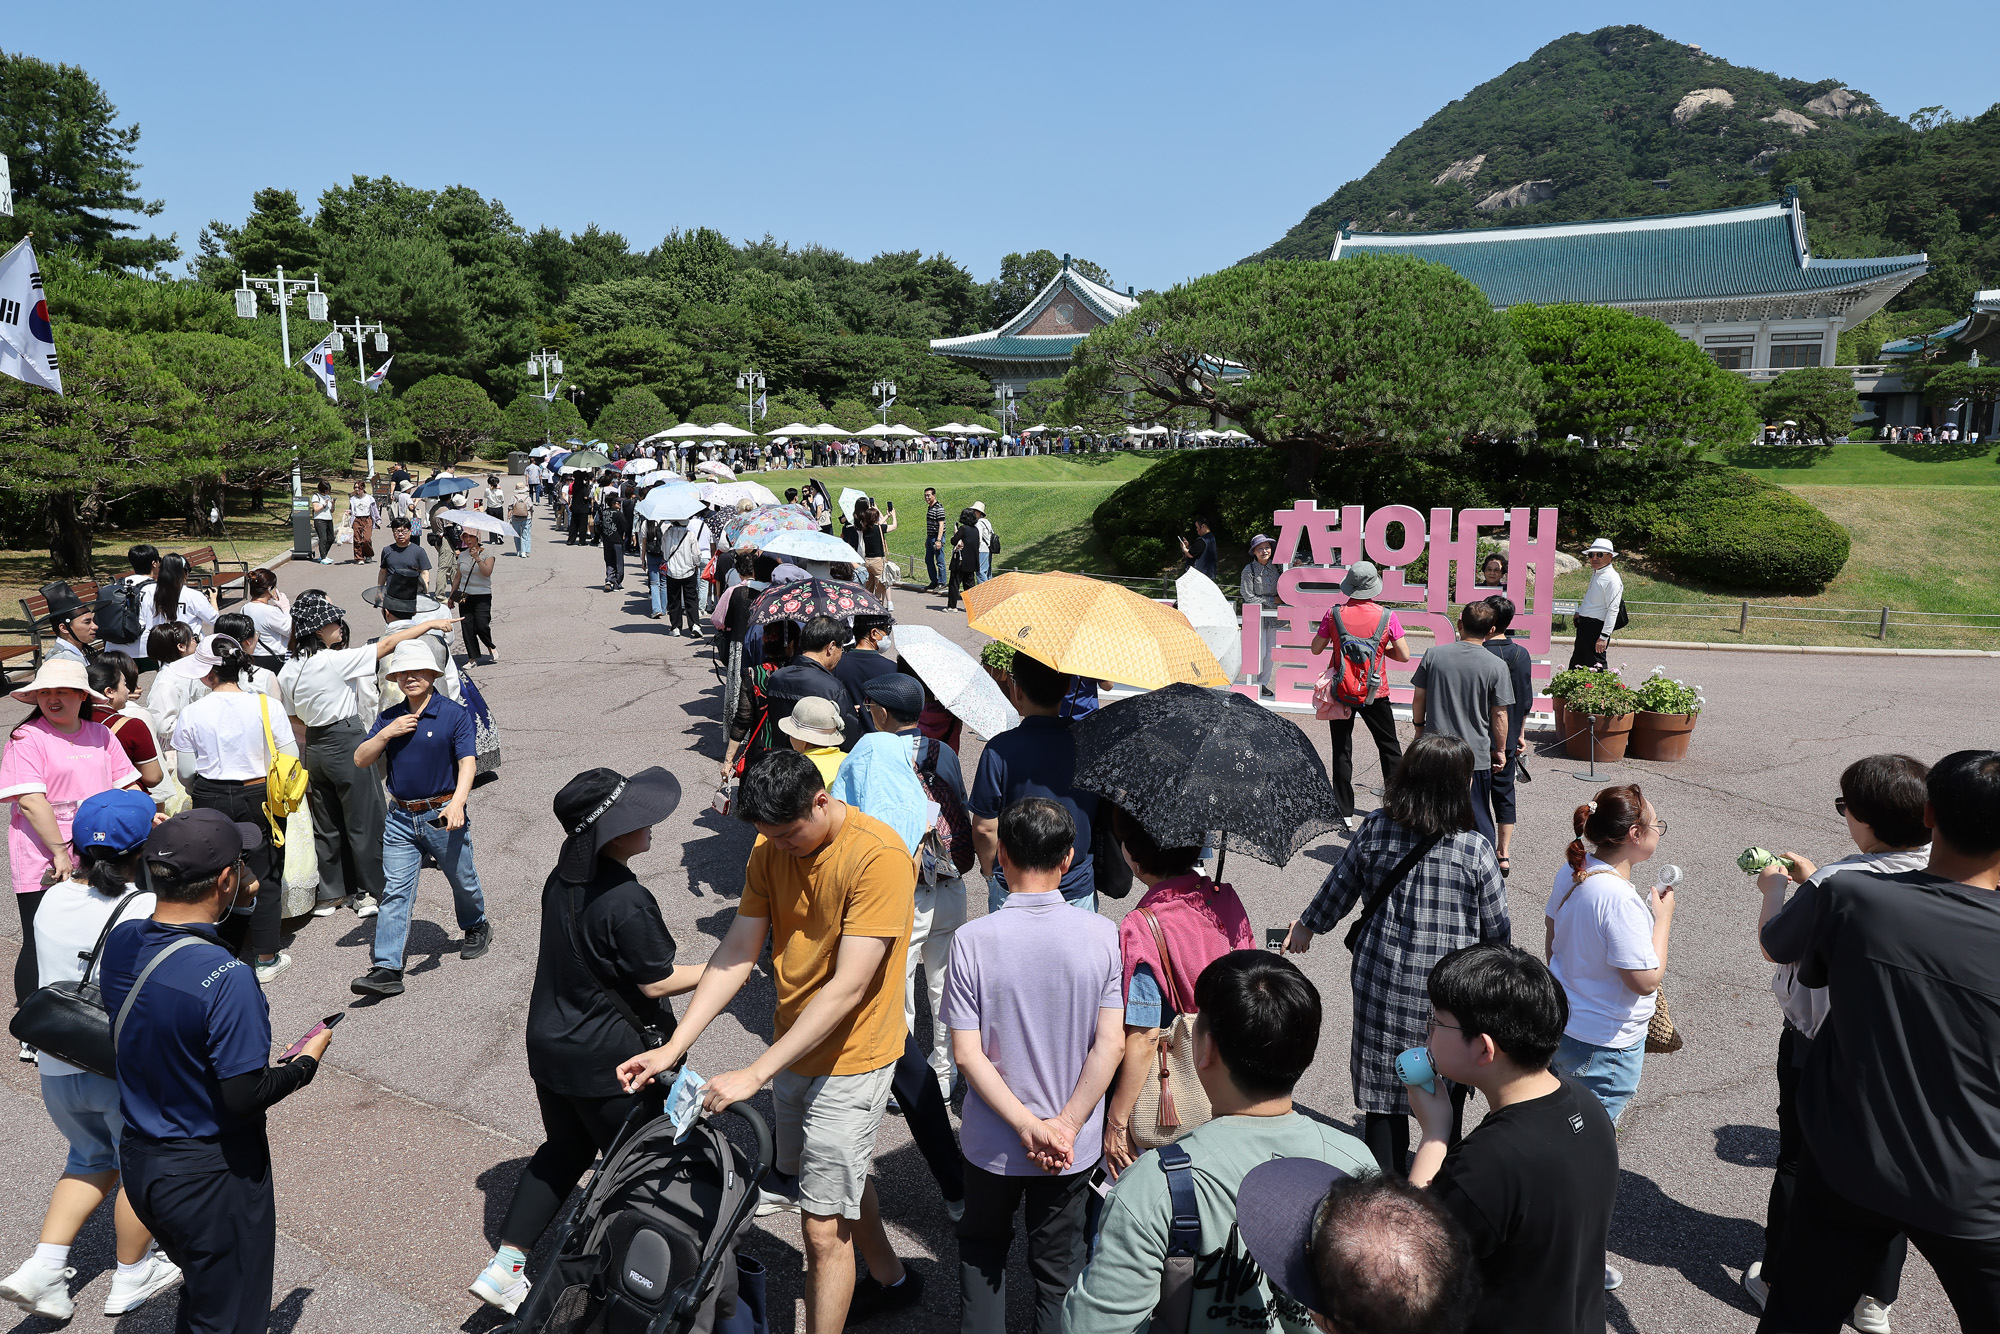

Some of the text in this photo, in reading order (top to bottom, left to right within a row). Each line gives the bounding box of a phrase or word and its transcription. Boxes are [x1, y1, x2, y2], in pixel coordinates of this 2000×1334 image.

[1272, 499, 1559, 614] 청와대
[1003, 636, 1026, 650] GOYARD
[629, 1269, 654, 1289] RECARO
